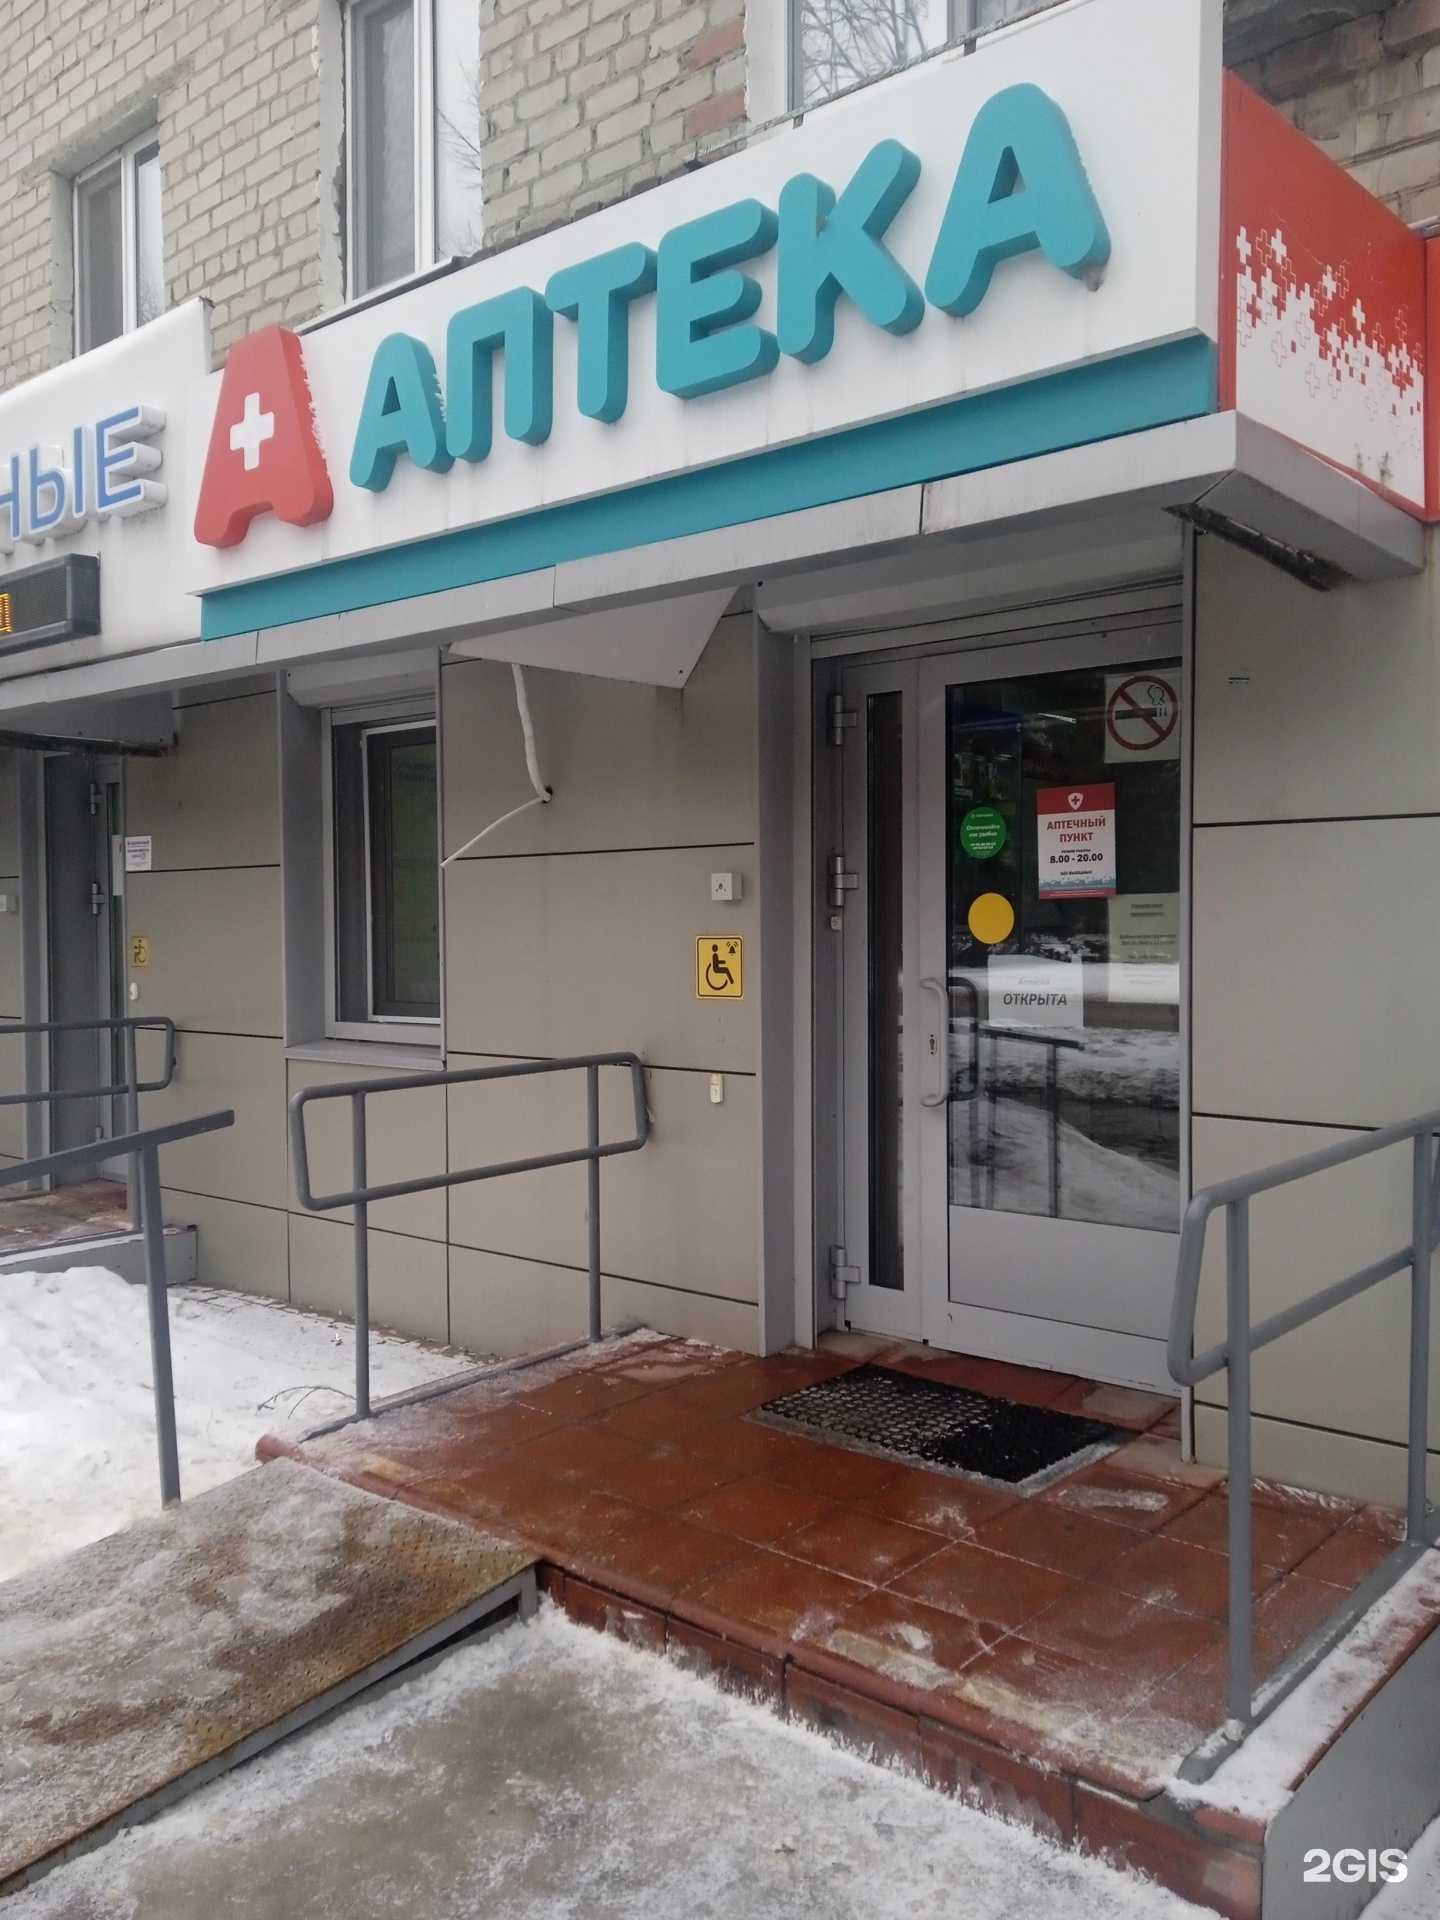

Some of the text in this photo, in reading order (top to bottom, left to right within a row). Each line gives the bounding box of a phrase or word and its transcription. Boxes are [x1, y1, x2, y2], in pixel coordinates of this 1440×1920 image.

[349, 82, 1111, 493] АПТЕКА
[1047, 816, 1106, 831] АПТЕЧНЫЙ
[1060, 832, 1094, 843] ПУНКТ
[1049, 855, 1070, 864] 8.00
[1077, 852, 1104, 863] 20.00
[1003, 993, 1068, 1006] ОТКРЫТА
